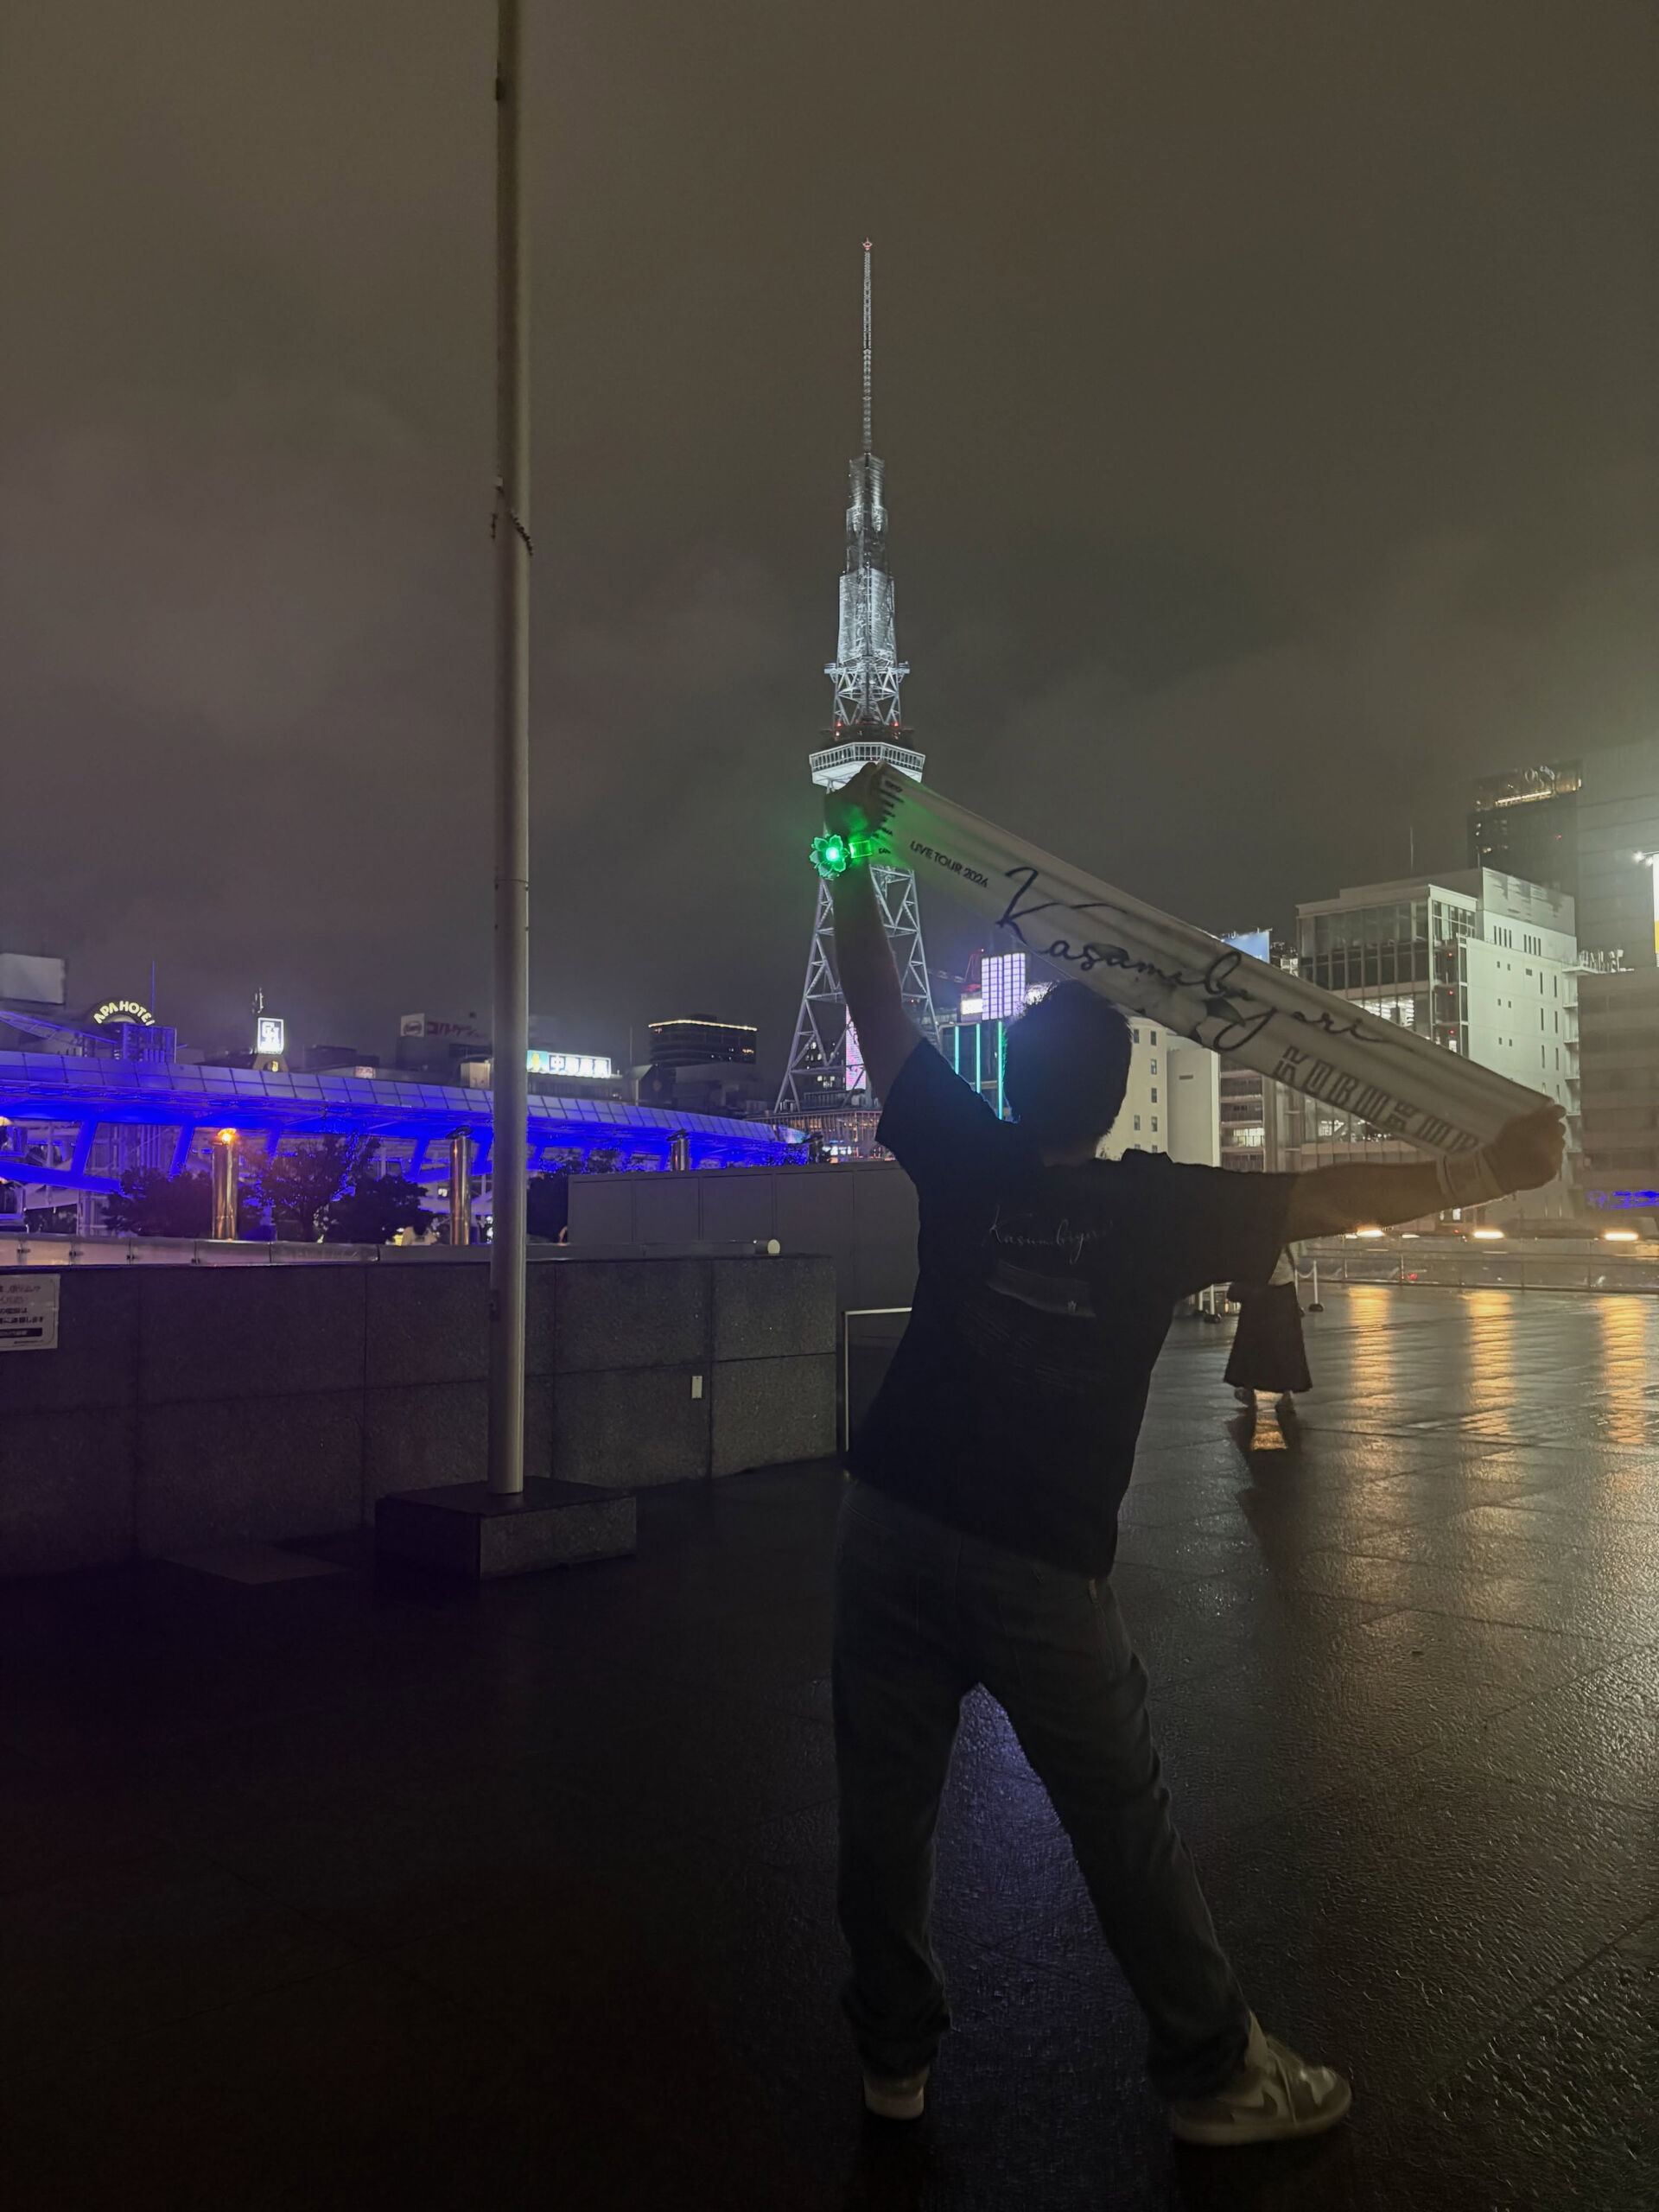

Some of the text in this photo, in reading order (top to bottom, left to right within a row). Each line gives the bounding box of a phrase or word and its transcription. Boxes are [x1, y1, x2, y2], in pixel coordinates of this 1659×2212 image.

[910, 841, 933, 860] LIVE
[934, 851, 963, 875] TOUR
[93, 1002, 118, 1024] APA
